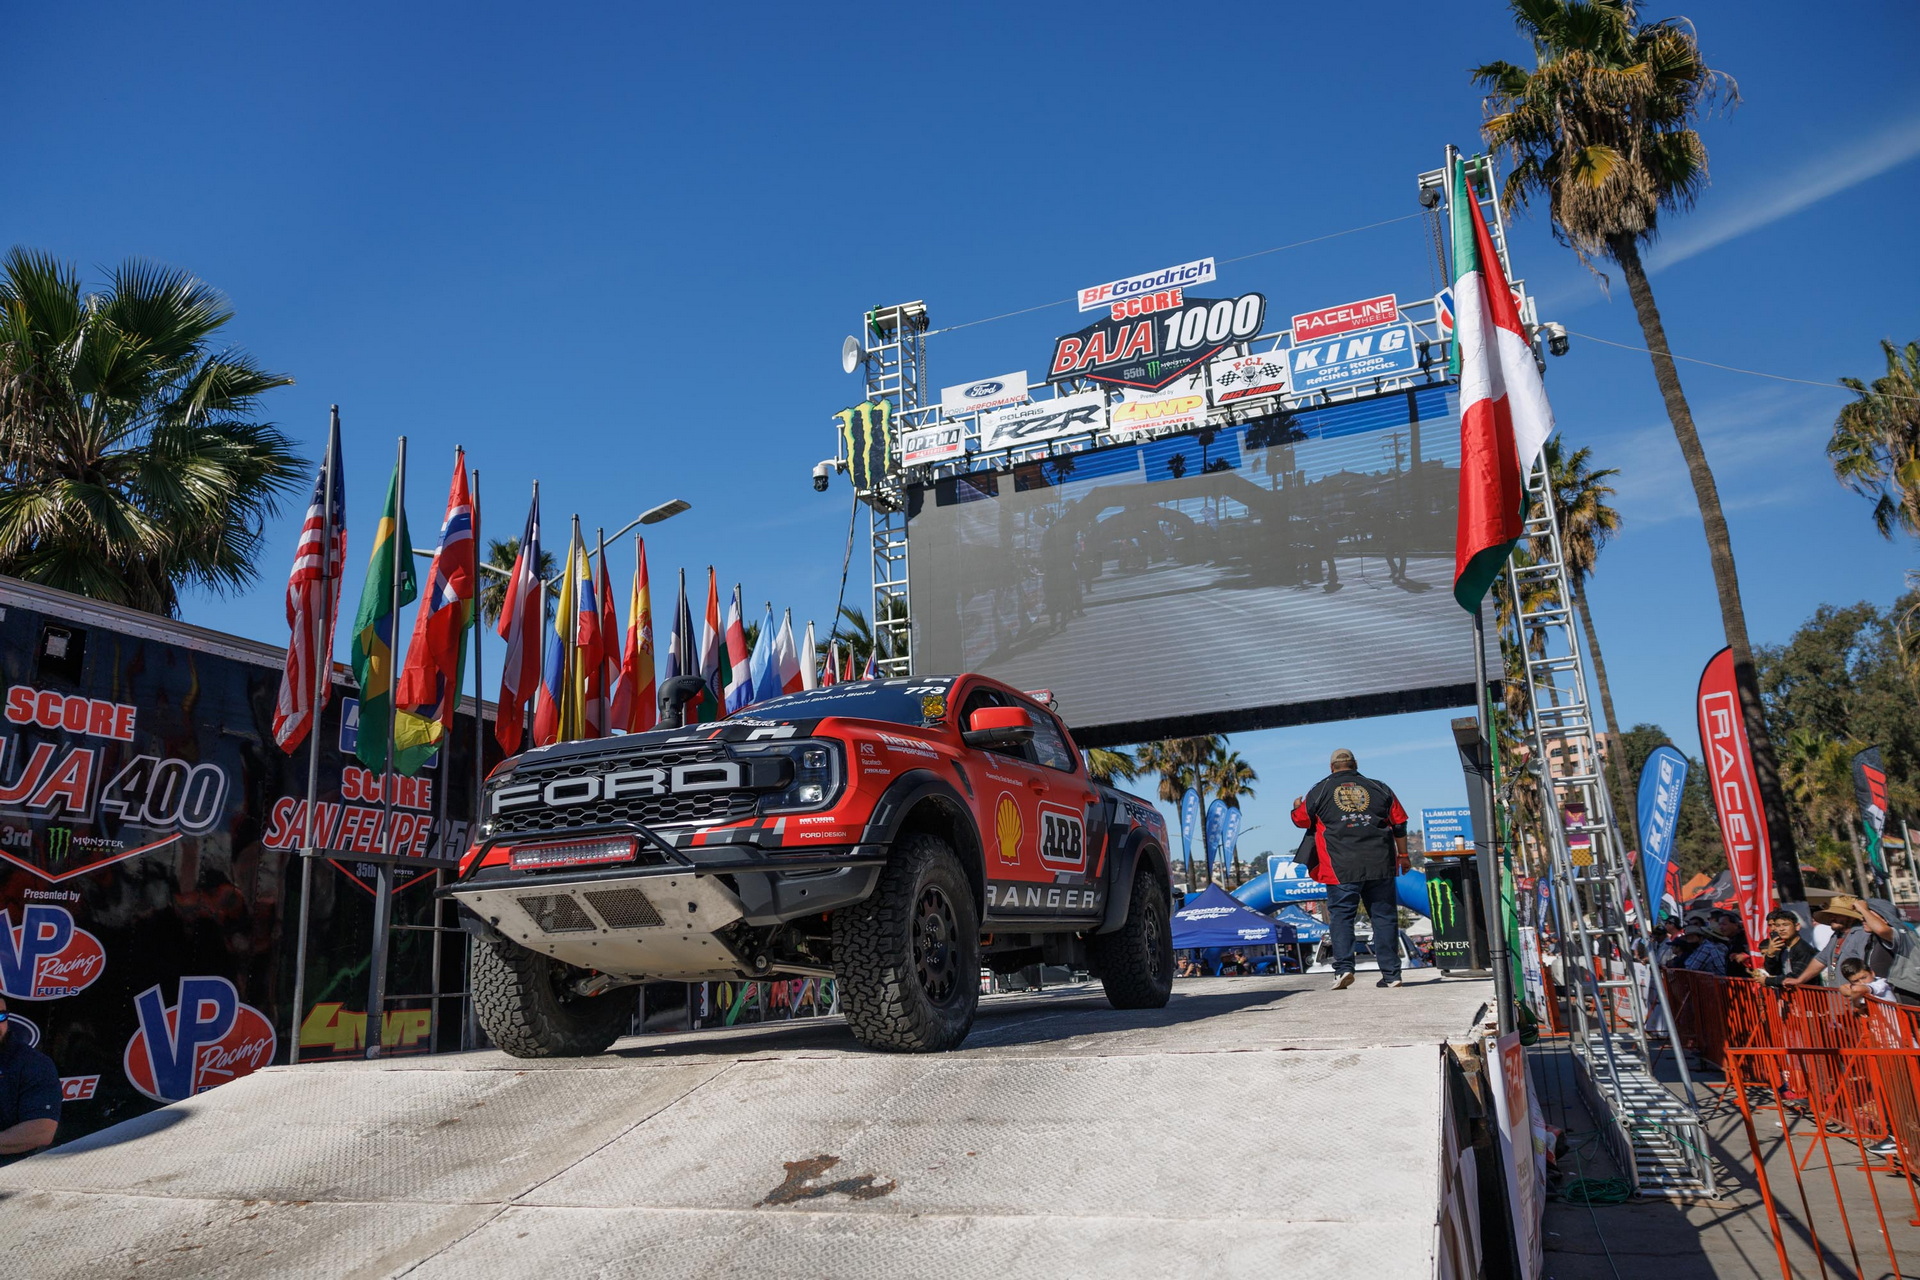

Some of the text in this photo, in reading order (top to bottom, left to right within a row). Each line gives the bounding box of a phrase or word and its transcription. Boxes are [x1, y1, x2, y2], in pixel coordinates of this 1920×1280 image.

[1081, 262, 1211, 304] BFGoodrich
[1111, 288, 1183, 321] SCORE
[1296, 300, 1393, 332] RACELINE
[1351, 311, 1394, 326] WHEELS
[1051, 294, 1260, 375] BAJA 1000
[1233, 357, 1264, 371] P.C.I.
[1294, 329, 1406, 372] KING
[1123, 357, 1191, 380] 55th MONSTER
[1306, 371, 1349, 385] RACING
[1318, 357, 1384, 375] OFF ROAD
[971, 384, 997, 397] Ford
[1137, 391, 1165, 399] Presented
[944, 394, 1026, 416] FORD PERFORMANCE
[1113, 395, 1203, 422] 4WP
[987, 404, 1102, 447] RZR
[785, 699, 810, 707] Shell
[811, 693, 844, 703] Biofuel
[846, 690, 876, 698] Blend
[903, 686, 946, 695] 773
[4, 685, 137, 742] SCORE
[100, 754, 225, 829] 400
[492, 763, 740, 815] FORD
[1650, 759, 1674, 854] KING
[1, 826, 124, 848] 3rd MONSTER
[262, 797, 341, 850] SAN
[1709, 707, 1760, 942] RACELINE
[1043, 815, 1082, 864] ARB
[356, 862, 376, 878] 35th
[24, 888, 80, 902] Presented by
[987, 885, 1095, 908] RANGER
[38, 953, 103, 985] Racing
[1223, 965, 1237, 974] STAFF
[36, 986, 80, 996] FUELS
[134, 976, 239, 1103] VP
[198, 1036, 274, 1083] Racing
